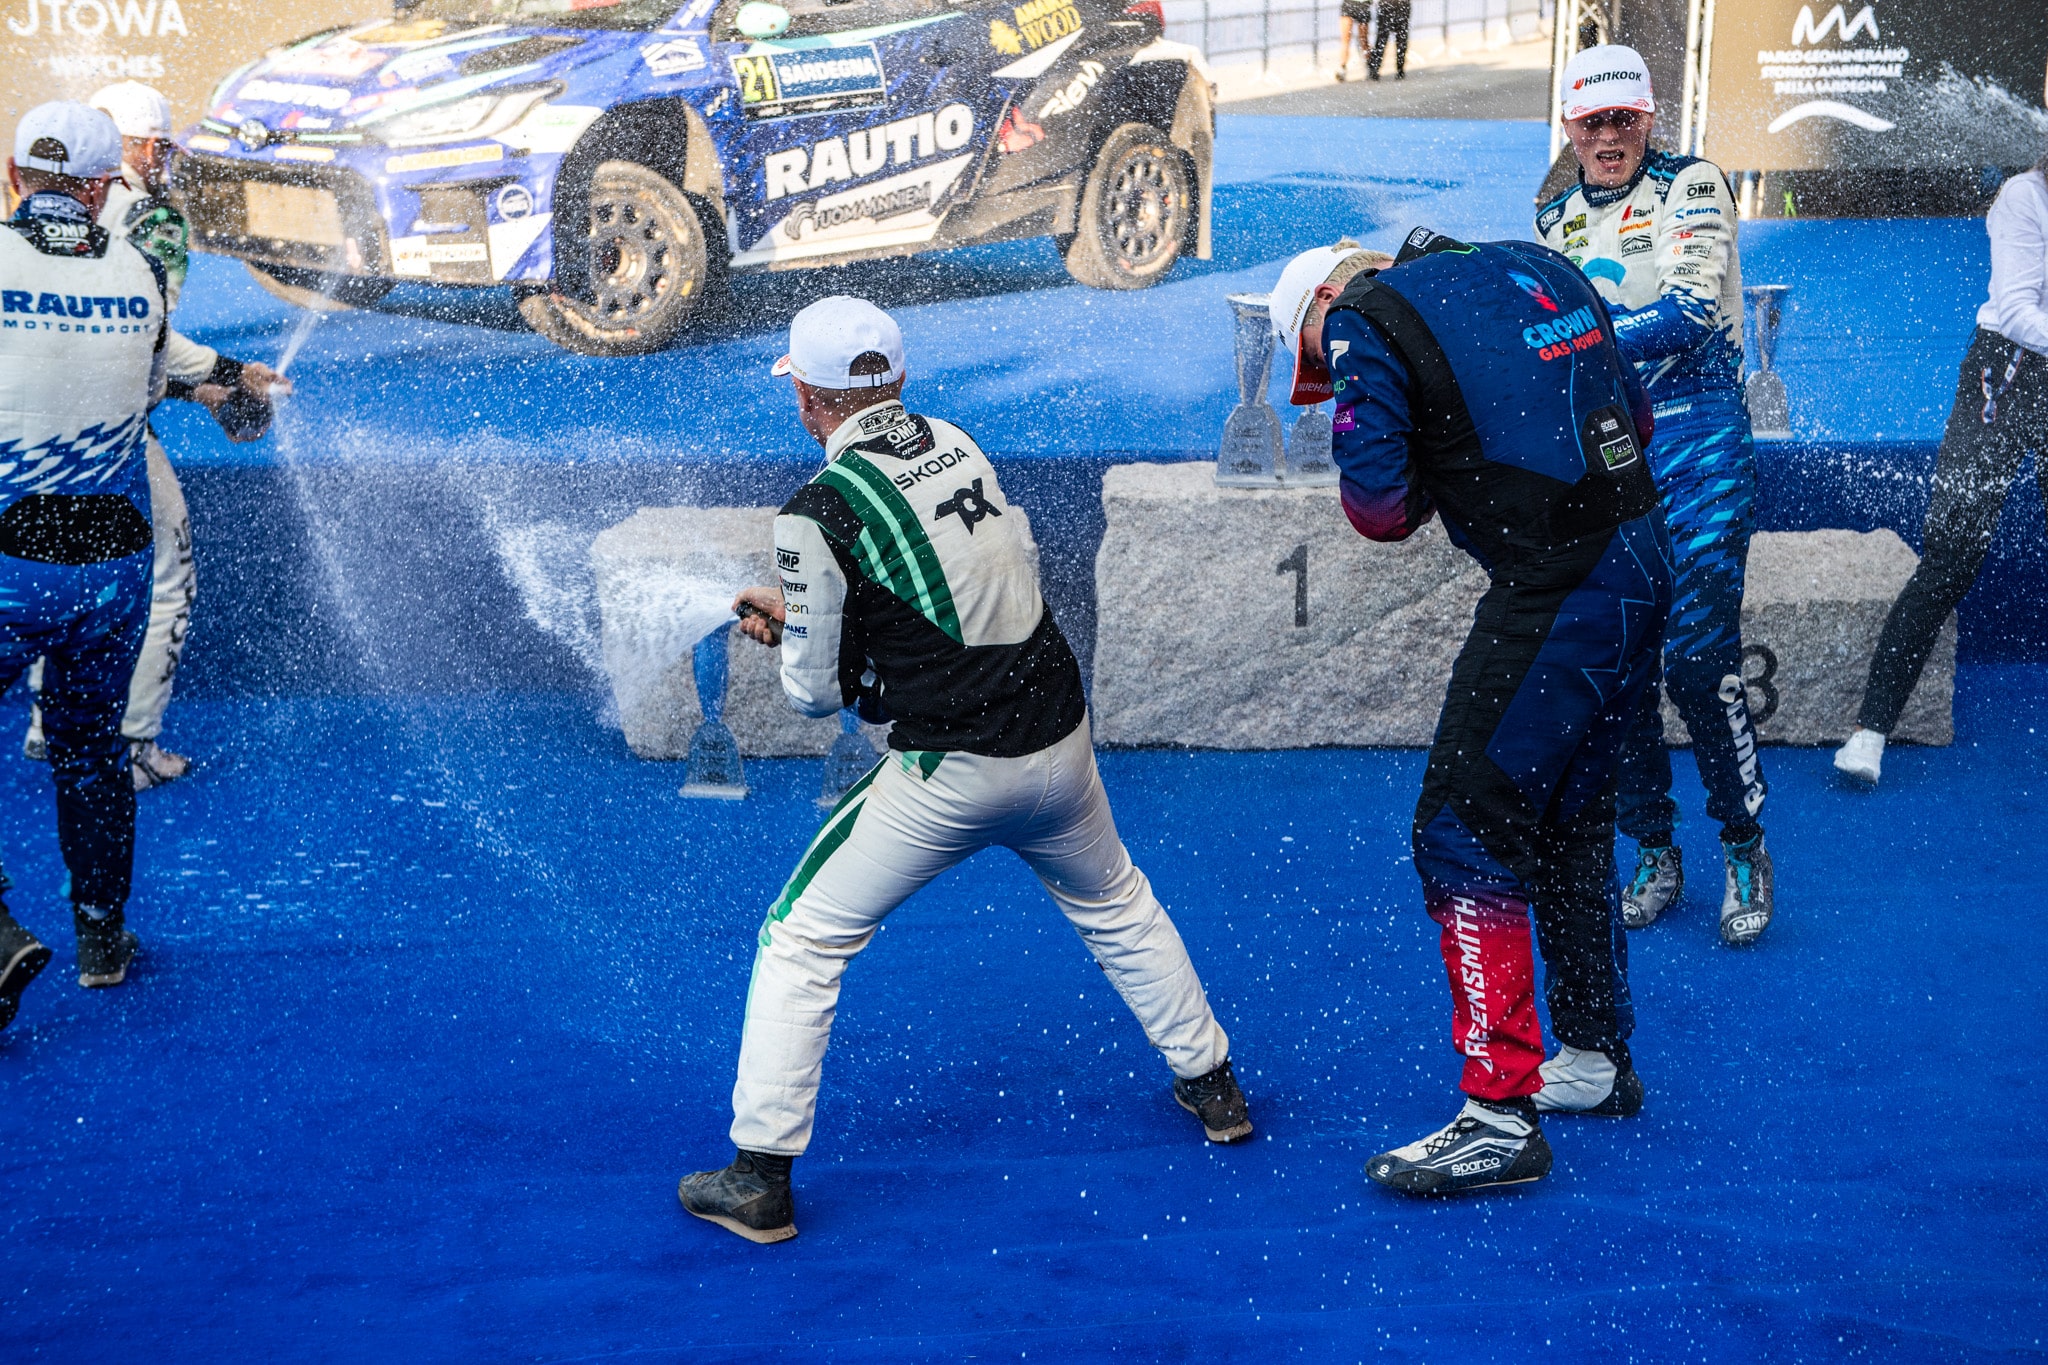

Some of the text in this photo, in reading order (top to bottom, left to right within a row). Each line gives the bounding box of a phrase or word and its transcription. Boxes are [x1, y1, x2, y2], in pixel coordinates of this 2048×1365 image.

[1020, 5, 1082, 49] WOOD
[736, 56, 774, 103] 21
[779, 57, 878, 86] SARDEGNA
[764, 103, 974, 201] RAUTIO
[1591, 184, 1630, 199] RAUTIO
[1686, 184, 1716, 197] OMP
[1541, 208, 1561, 227] OMP
[1686, 206, 1721, 216] RAUTIO
[42, 222, 90, 240] OMP
[1, 290, 149, 319] RAUTIO
[3, 320, 150, 334] MOTORSPORT
[1523, 305, 1598, 348] CROWN
[1613, 309, 1658, 329] AUTIO
[1538, 328, 1603, 361] GAS POWER
[887, 421, 918, 443] OMP
[777, 551, 799, 568] OMP
[1276, 544, 1307, 627] 1
[1742, 645, 1779, 725] 3
[1718, 674, 1766, 816] RAUTIO
[1732, 916, 1769, 931] OMP
[1452, 1157, 1500, 1176] sparco
